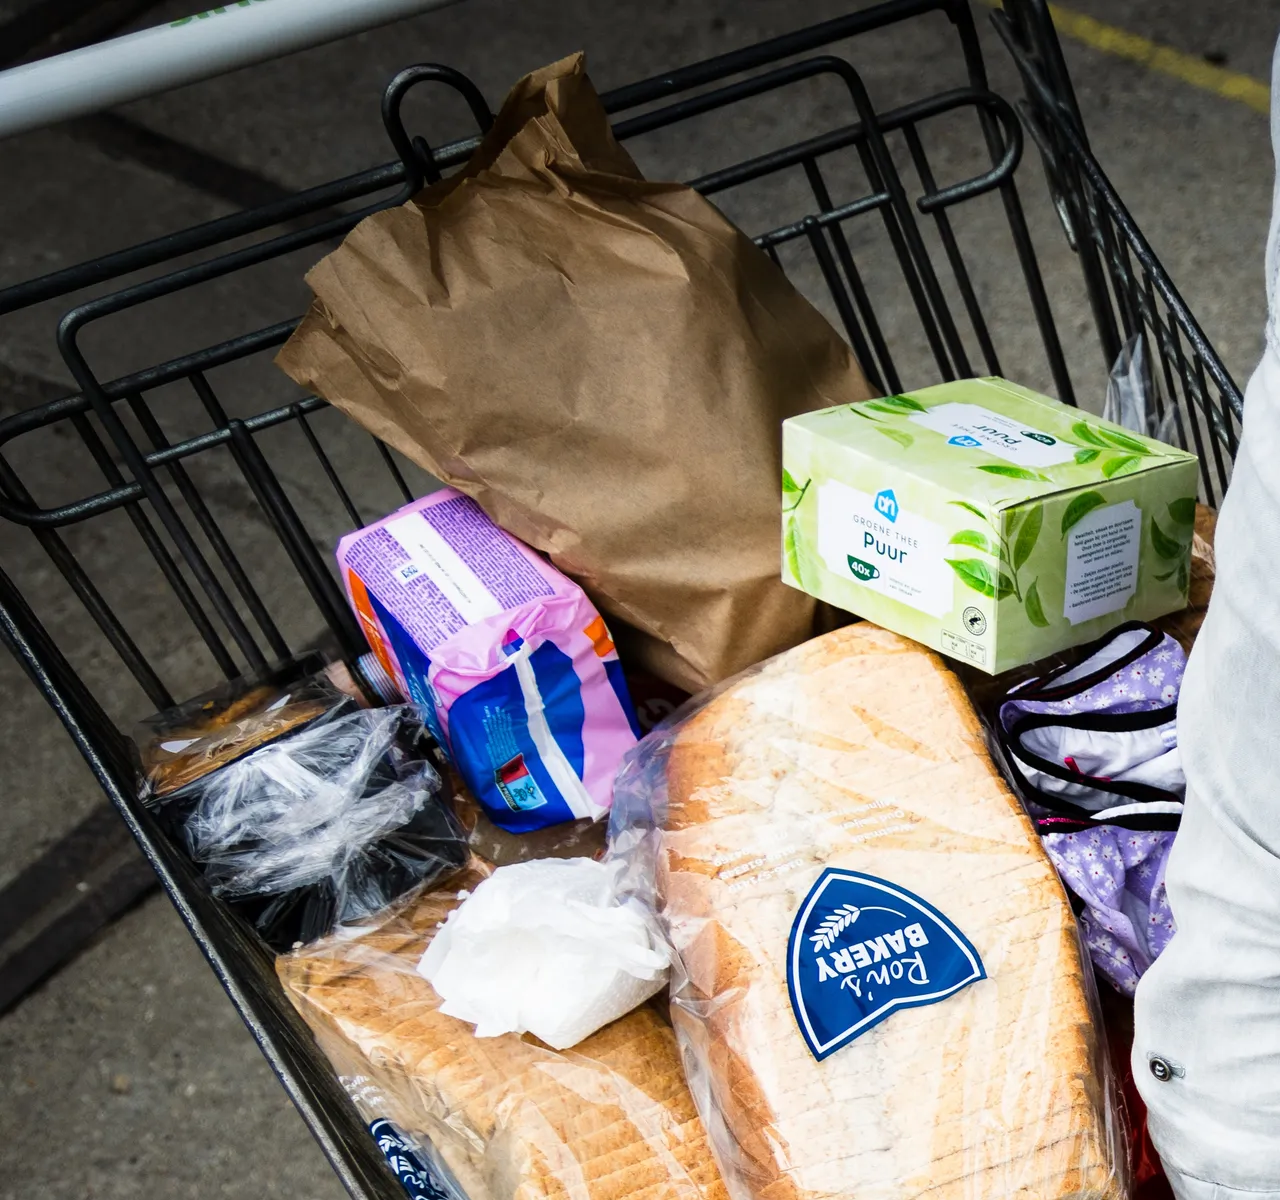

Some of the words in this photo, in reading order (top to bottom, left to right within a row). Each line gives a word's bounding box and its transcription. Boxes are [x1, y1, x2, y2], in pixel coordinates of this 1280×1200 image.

[853, 515, 890, 536] GROENE
[895, 532, 918, 548] THEE
[864, 532, 908, 563] Puur
[852, 562, 870, 576] 40x
[816, 923, 929, 982] BAKERY
[840, 951, 929, 1000] Ron's
